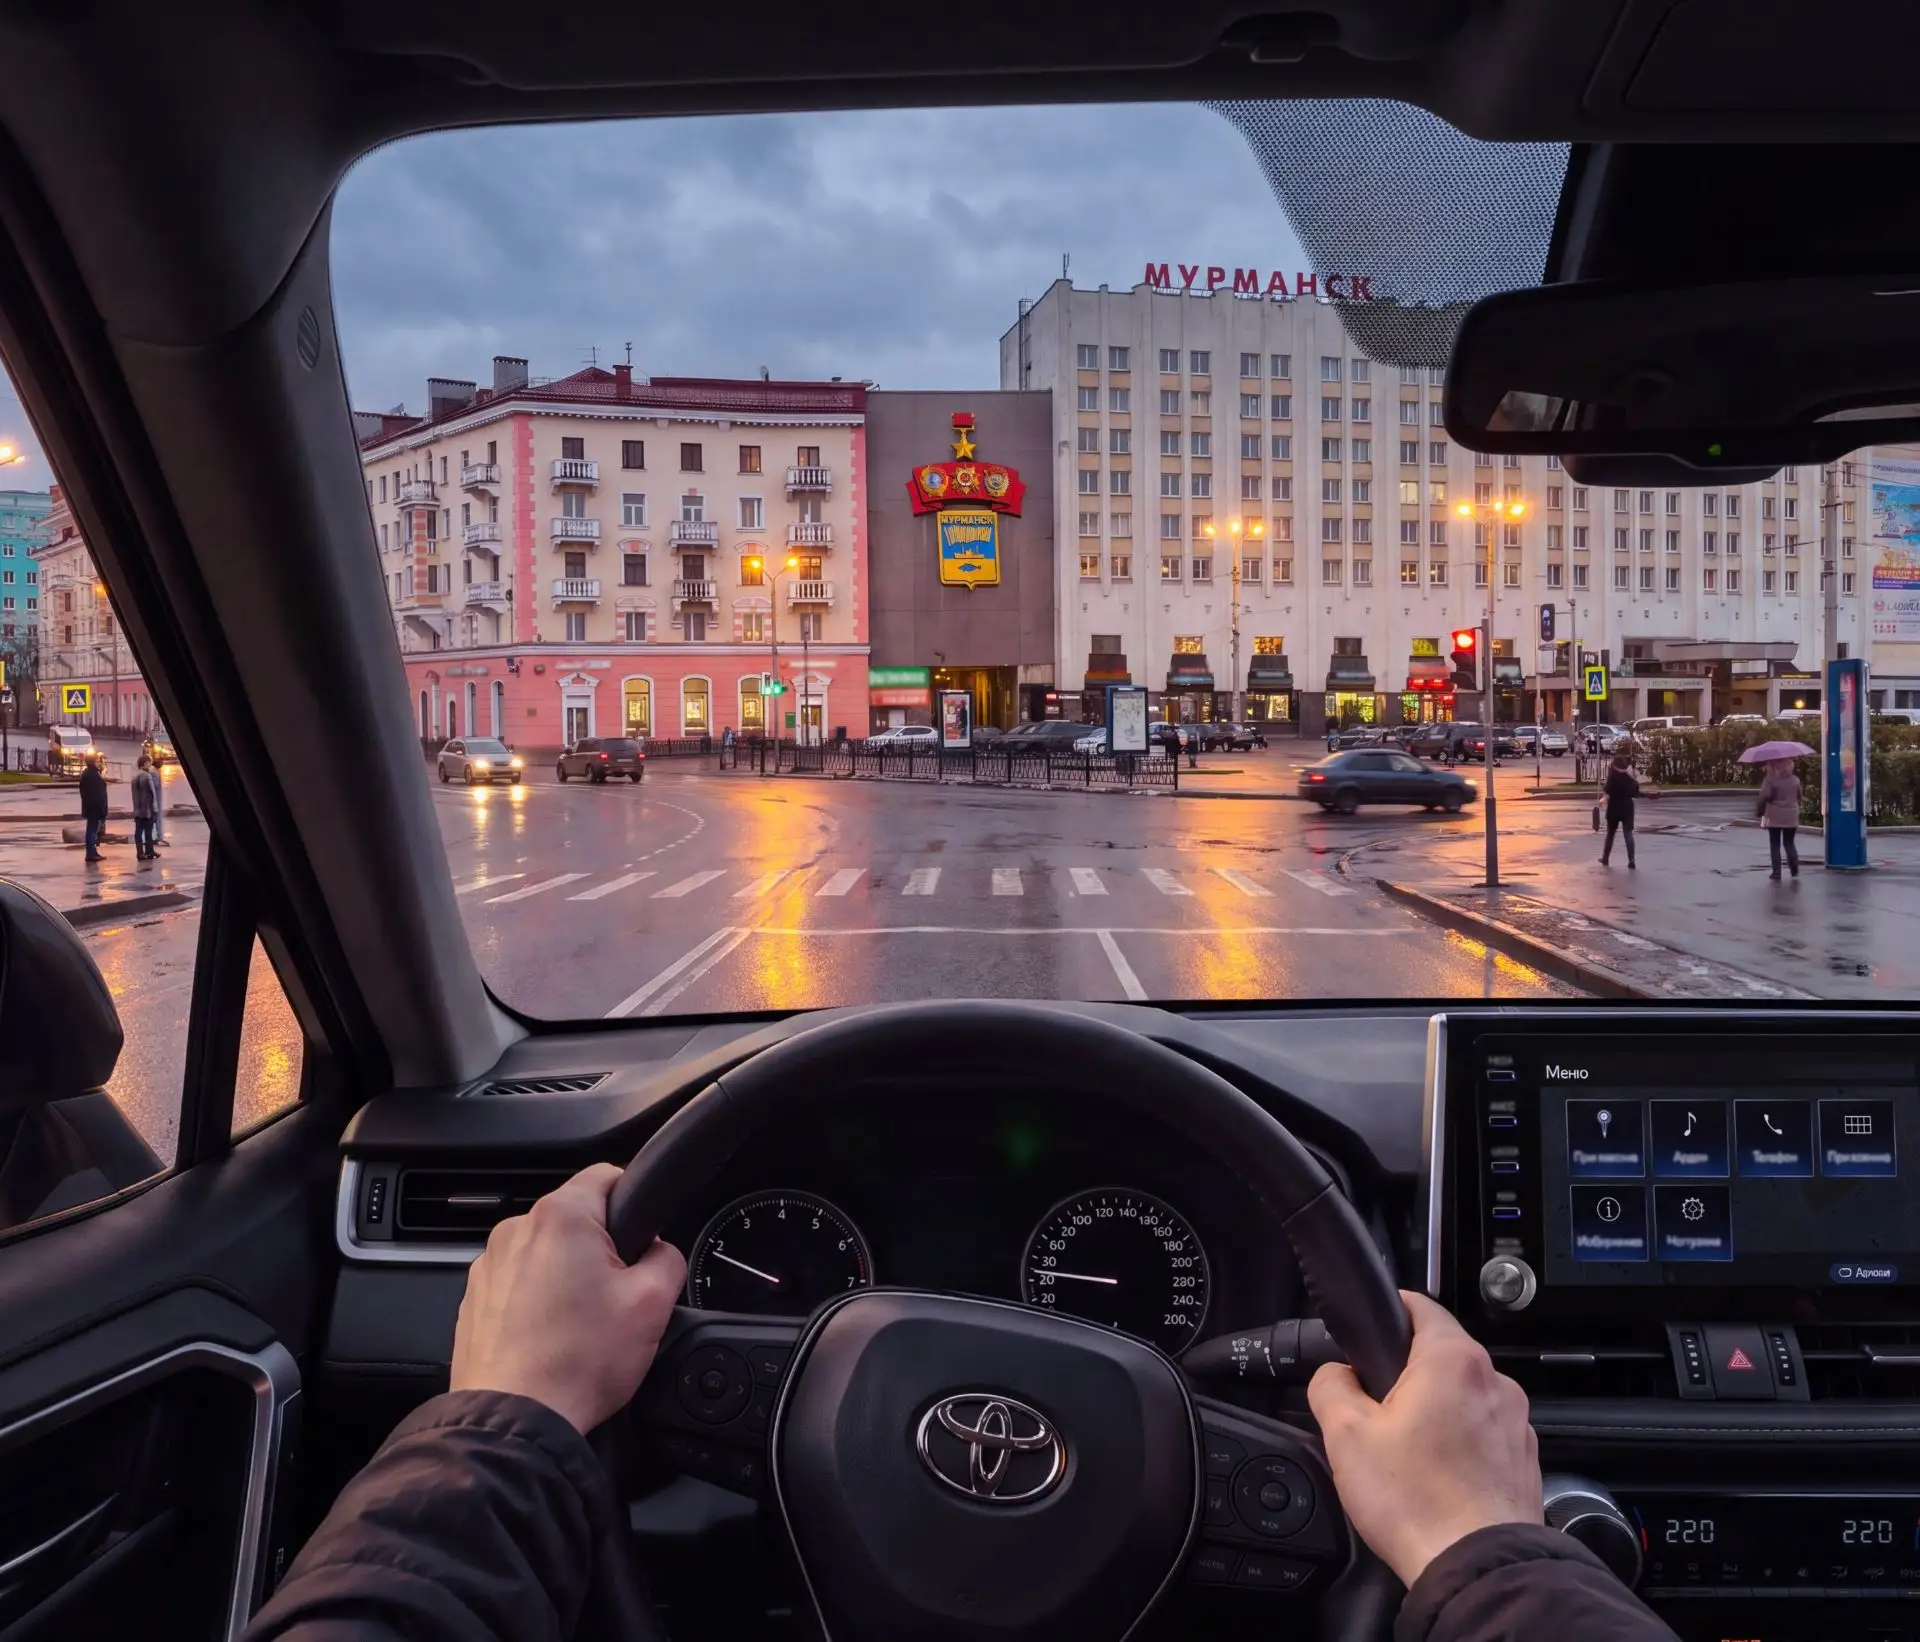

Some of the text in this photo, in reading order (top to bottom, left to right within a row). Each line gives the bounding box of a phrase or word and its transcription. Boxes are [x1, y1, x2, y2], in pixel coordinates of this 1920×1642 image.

[1144, 262, 1373, 301] МУРМАНСК
[941, 515, 994, 525] МУРМАНСК
[1545, 1064, 1589, 1080] Меню
[777, 1209, 786, 1220] 4
[1095, 1207, 1114, 1218] 120
[1118, 1207, 1137, 1218] 140
[743, 1218, 751, 1230] 3
[812, 1218, 820, 1230] 5
[1072, 1215, 1092, 1226] 100
[1060, 1226, 1077, 1237] 20
[1153, 1226, 1173, 1237] 160
[716, 1240, 725, 1251] 2
[838, 1239, 847, 1251] 6
[1049, 1239, 1066, 1251] 60
[1163, 1239, 1184, 1252] 180
[1041, 1256, 1057, 1268] 30
[1171, 1257, 1193, 1269] 200
[705, 1276, 712, 1288] 1
[847, 1276, 855, 1288] 7
[1039, 1274, 1055, 1286] 20
[1041, 1293, 1056, 1305] 20
[1172, 1294, 1194, 1306] 240
[1164, 1313, 1187, 1326] 200
[1665, 1519, 1715, 1544] 220
[1842, 1519, 1893, 1544] 220
